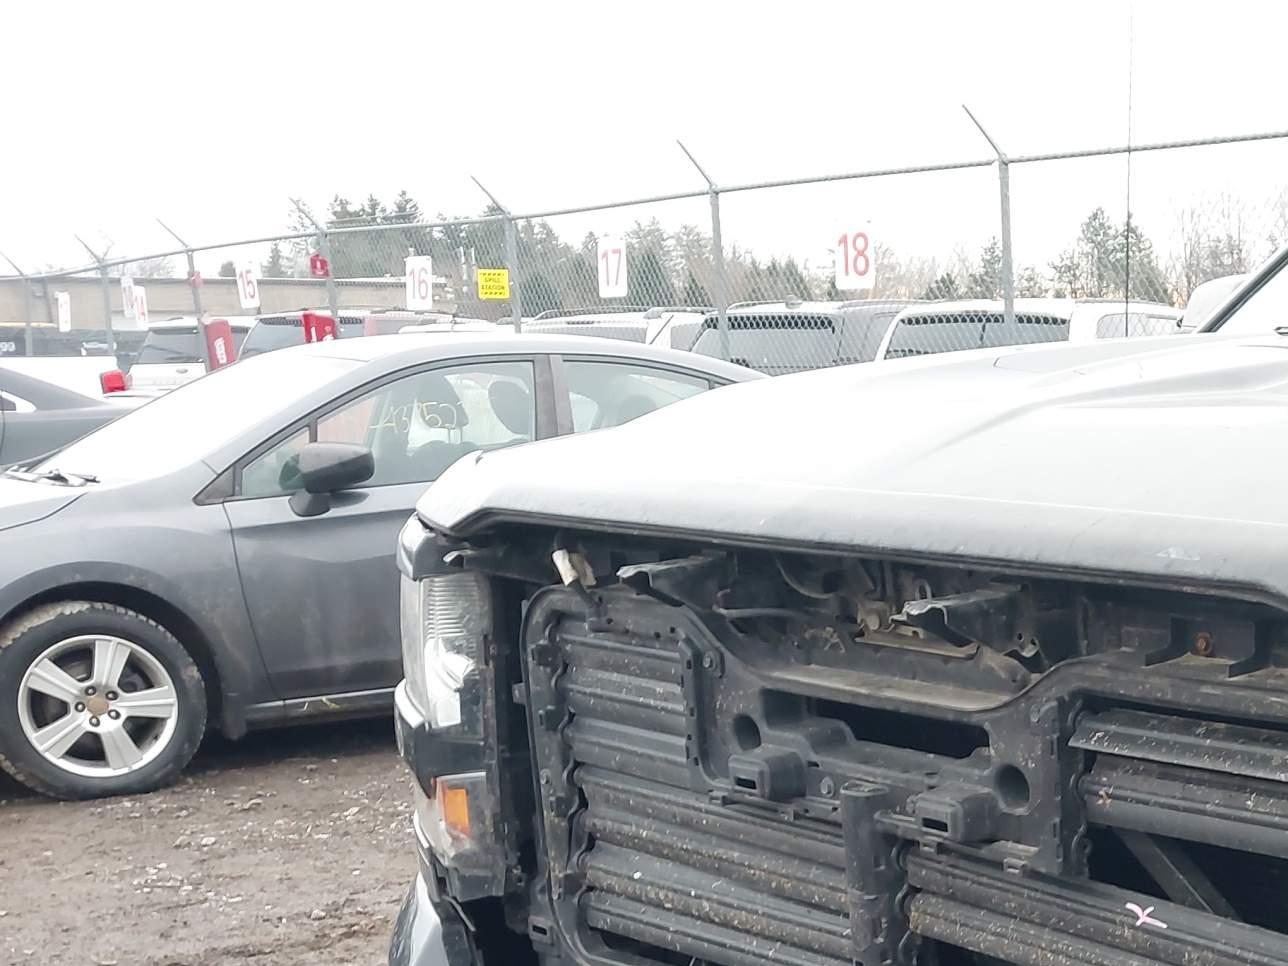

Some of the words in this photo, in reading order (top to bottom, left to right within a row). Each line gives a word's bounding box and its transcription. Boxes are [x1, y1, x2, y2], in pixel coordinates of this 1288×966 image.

[601, 248, 621, 287] 17
[838, 231, 869, 277] 18
[238, 268, 257, 301] 15
[409, 266, 428, 300] 16
